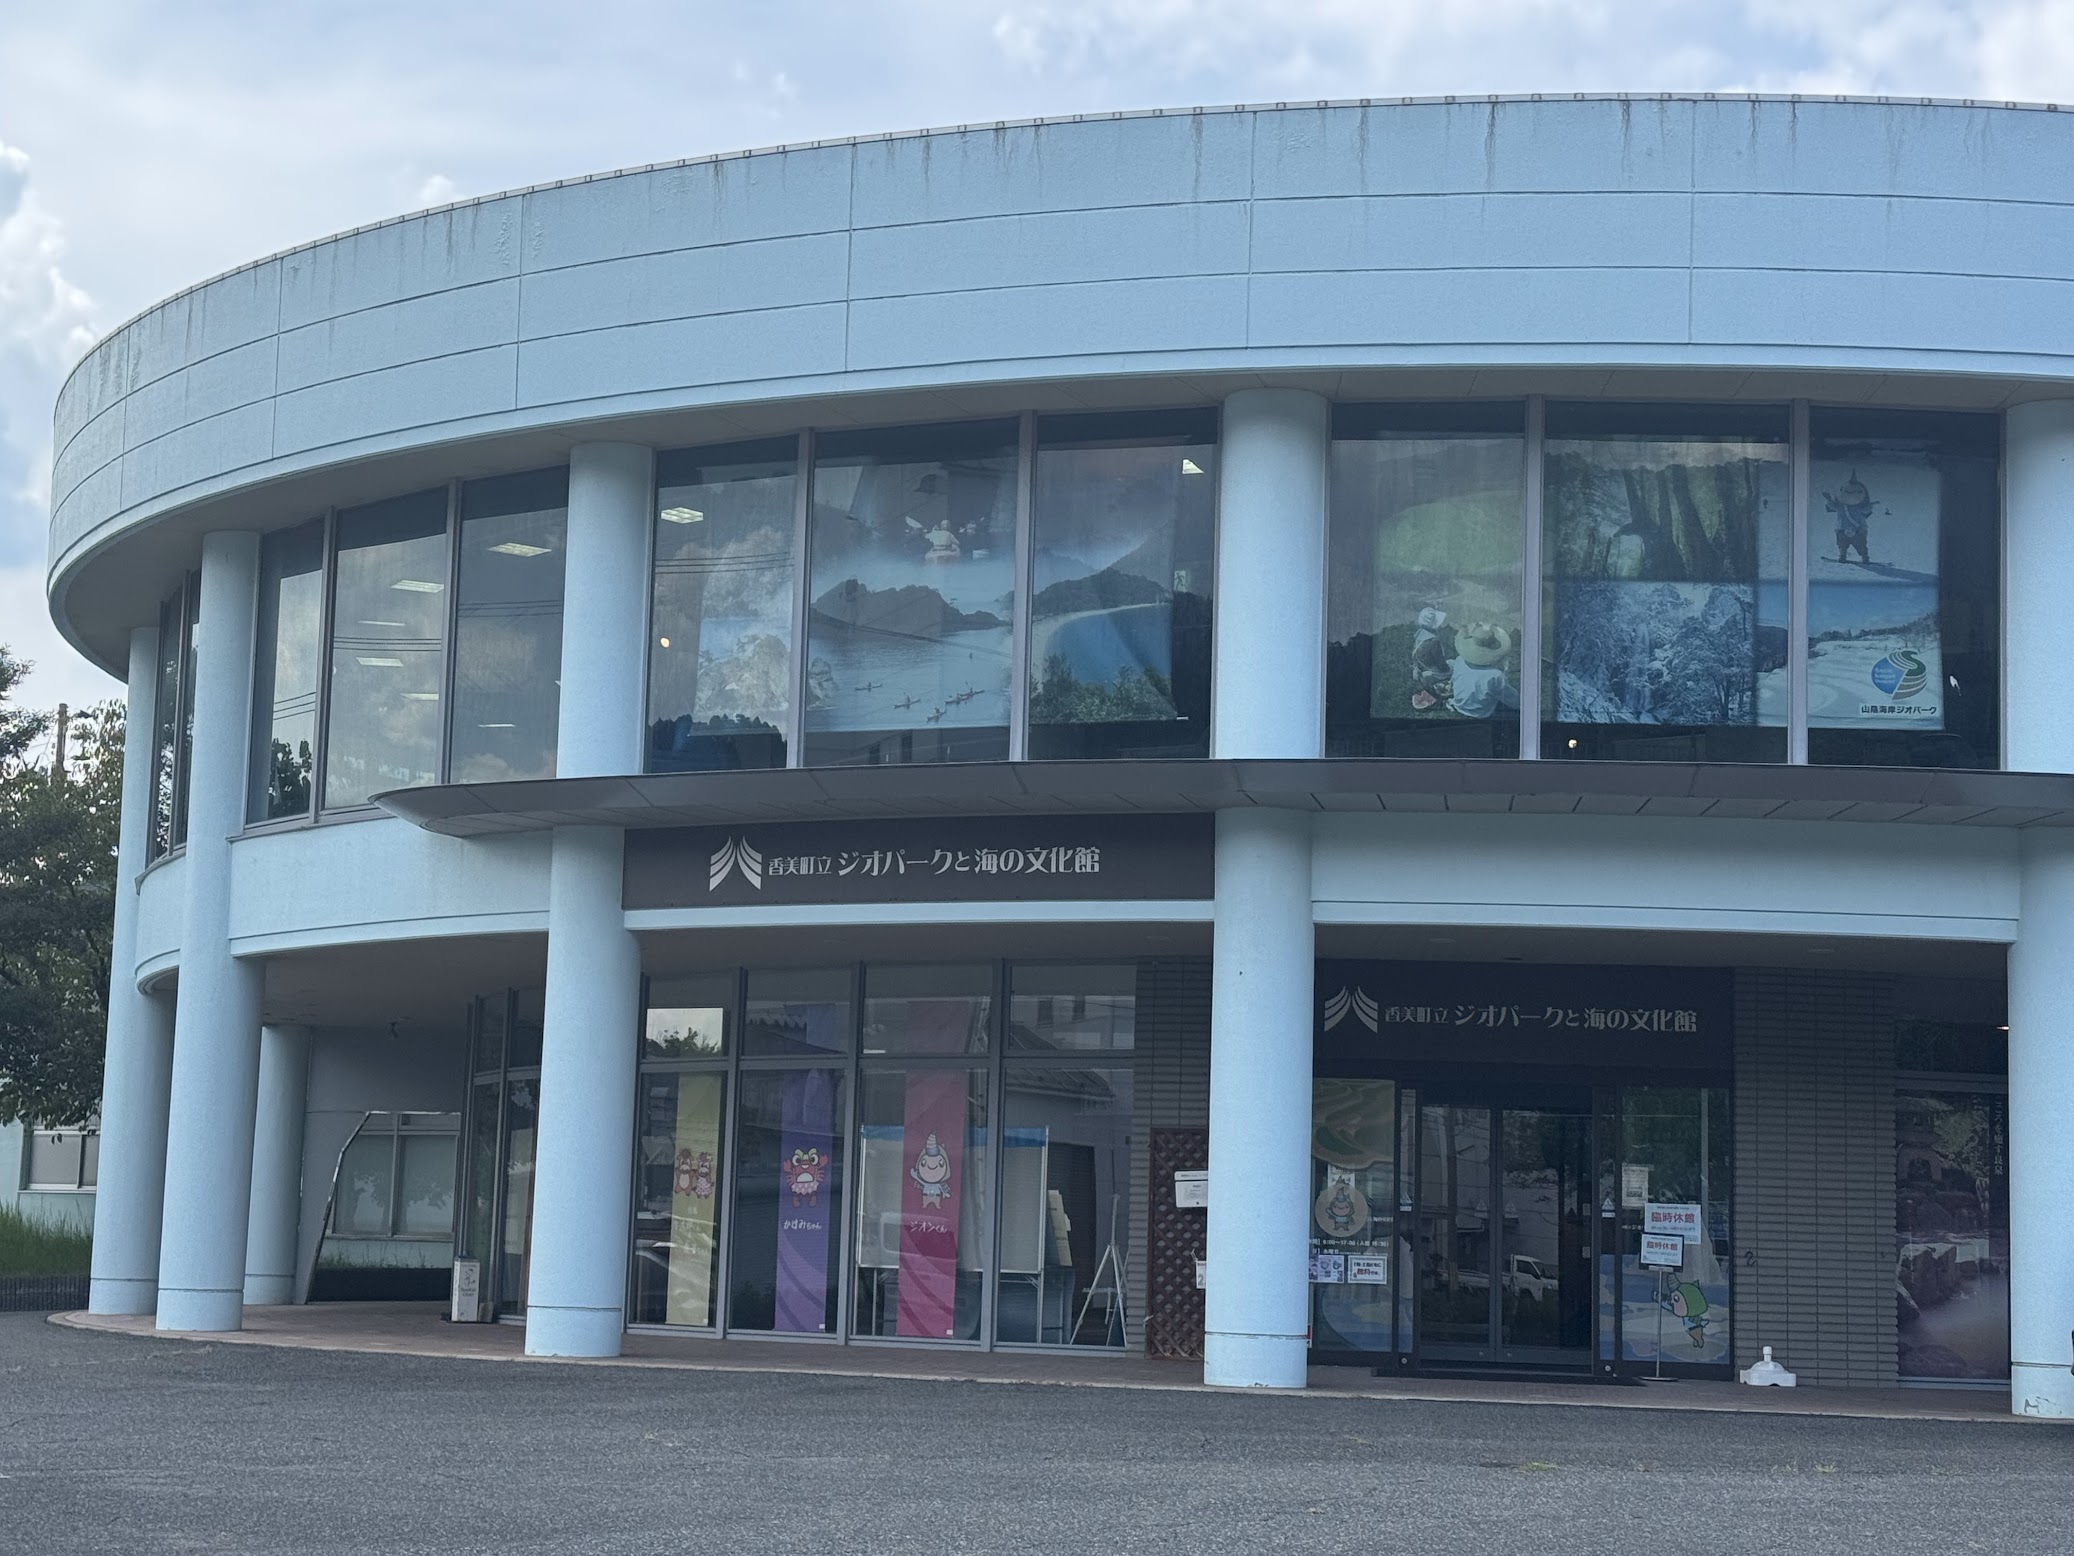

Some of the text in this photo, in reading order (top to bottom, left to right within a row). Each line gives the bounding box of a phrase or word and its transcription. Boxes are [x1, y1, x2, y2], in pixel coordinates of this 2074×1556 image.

[1861, 705, 1937, 715] 山陰海岸ジオパーク
[783, 1218, 822, 1230] かすみちゃん
[1651, 1212, 1695, 1224] 臨時休館
[910, 1221, 948, 1233] ジオンくん
